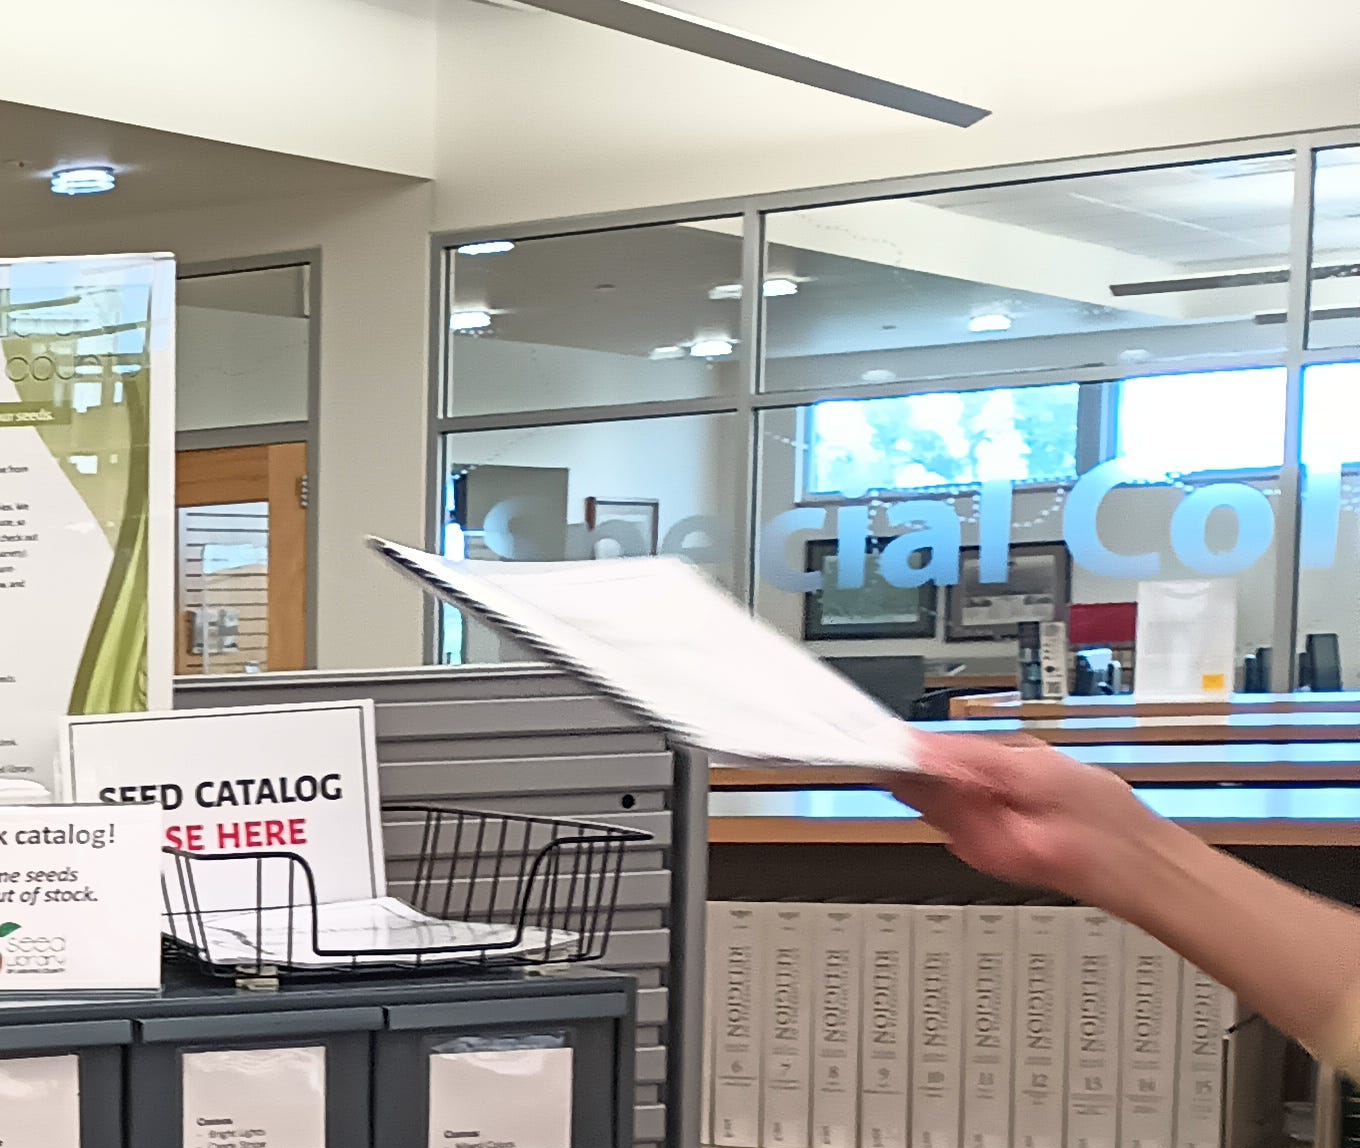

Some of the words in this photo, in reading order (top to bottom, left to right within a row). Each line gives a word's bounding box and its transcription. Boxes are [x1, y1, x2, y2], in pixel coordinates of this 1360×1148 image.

[15, 823, 116, 850] catalog!
[99, 784, 182, 811] SEED
[193, 772, 343, 810] CATALOG
[216, 818, 308, 850] HERE
[20, 886, 41, 906] of
[44, 886, 98, 904] stock.
[25, 866, 79, 883] seeds
[728, 946, 745, 1038] RELIGION
[775, 948, 793, 1040] RELIGION
[823, 950, 841, 1043] RELIGION
[872, 950, 891, 1044] RELIGION
[923, 952, 942, 1046] RELIGION
[975, 953, 994, 1049] RELIGION
[1027, 953, 1046, 1049] RELIGION
[1080, 955, 1099, 1052] RELIGION
[1135, 955, 1154, 1053] RELIGION
